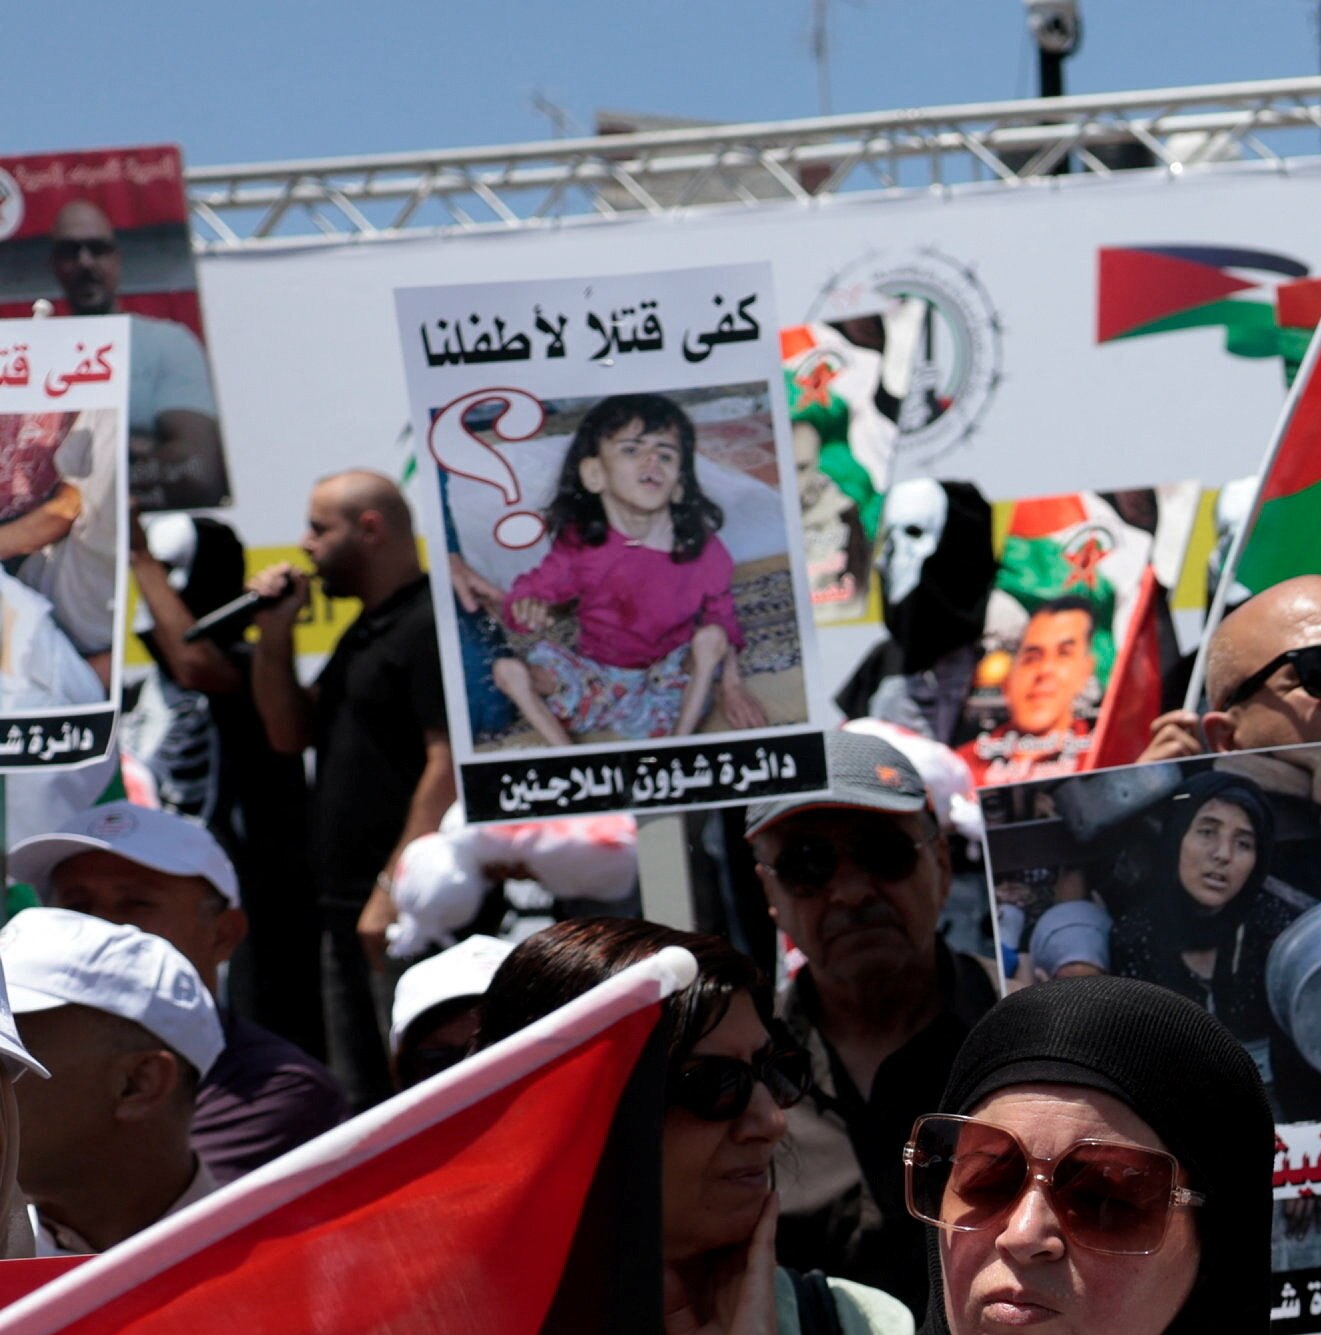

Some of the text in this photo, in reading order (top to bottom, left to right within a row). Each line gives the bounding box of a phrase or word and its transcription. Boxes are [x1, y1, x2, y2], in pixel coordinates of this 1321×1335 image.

[681, 293, 761, 363] كفى
[44, 342, 114, 398] كفى
[28, 721, 95, 761] دائرة
[499, 748, 797, 812] دائرة شؤون اللاجئين
